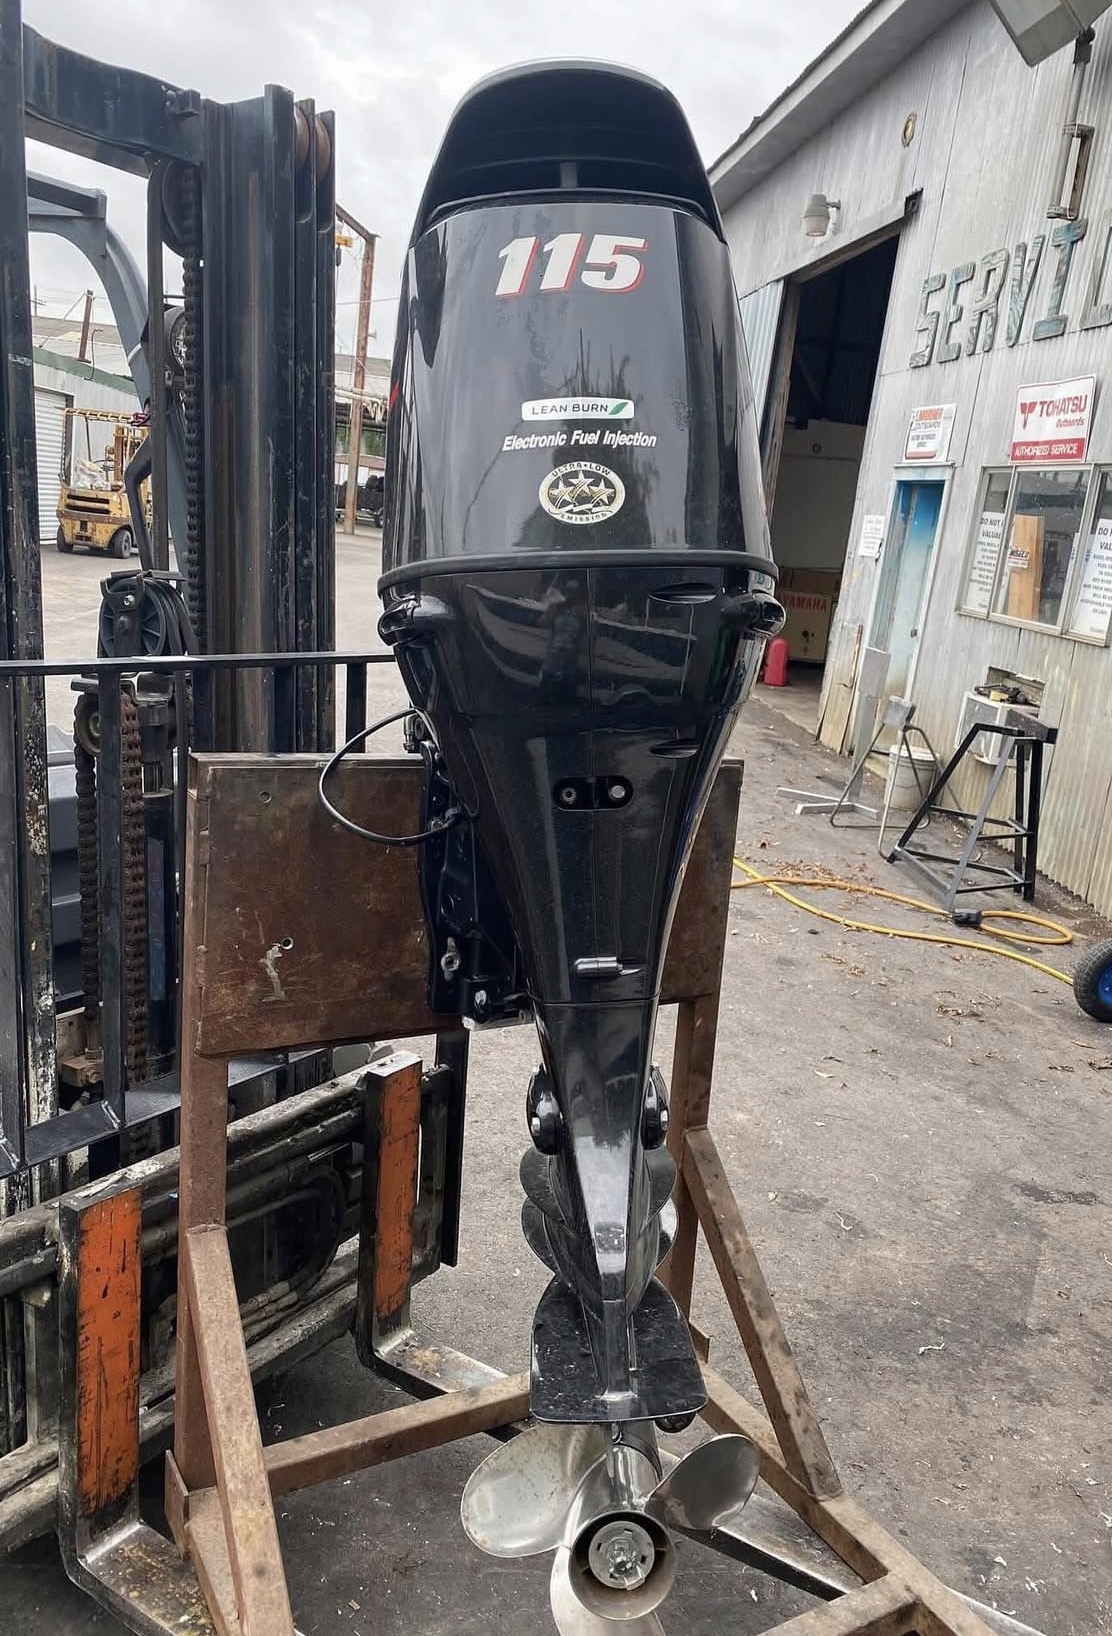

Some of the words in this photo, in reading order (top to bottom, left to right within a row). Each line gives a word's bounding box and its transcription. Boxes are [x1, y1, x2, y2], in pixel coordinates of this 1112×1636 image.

[495, 233, 649, 298] 115
[531, 404, 568, 416] LEAN
[572, 403, 609, 413] BURN
[1039, 394, 1088, 417] TOHATSU
[502, 431, 567, 451] Electronic
[570, 430, 600, 446] Fuel
[603, 430, 657, 449] Injection
[1050, 443, 1079, 455] SERVICE
[552, 462, 582, 477] ULTRA
[589, 462, 611, 476] LOW
[1098, 527, 1109, 536] DO
[783, 593, 827, 612] YAMAHA
